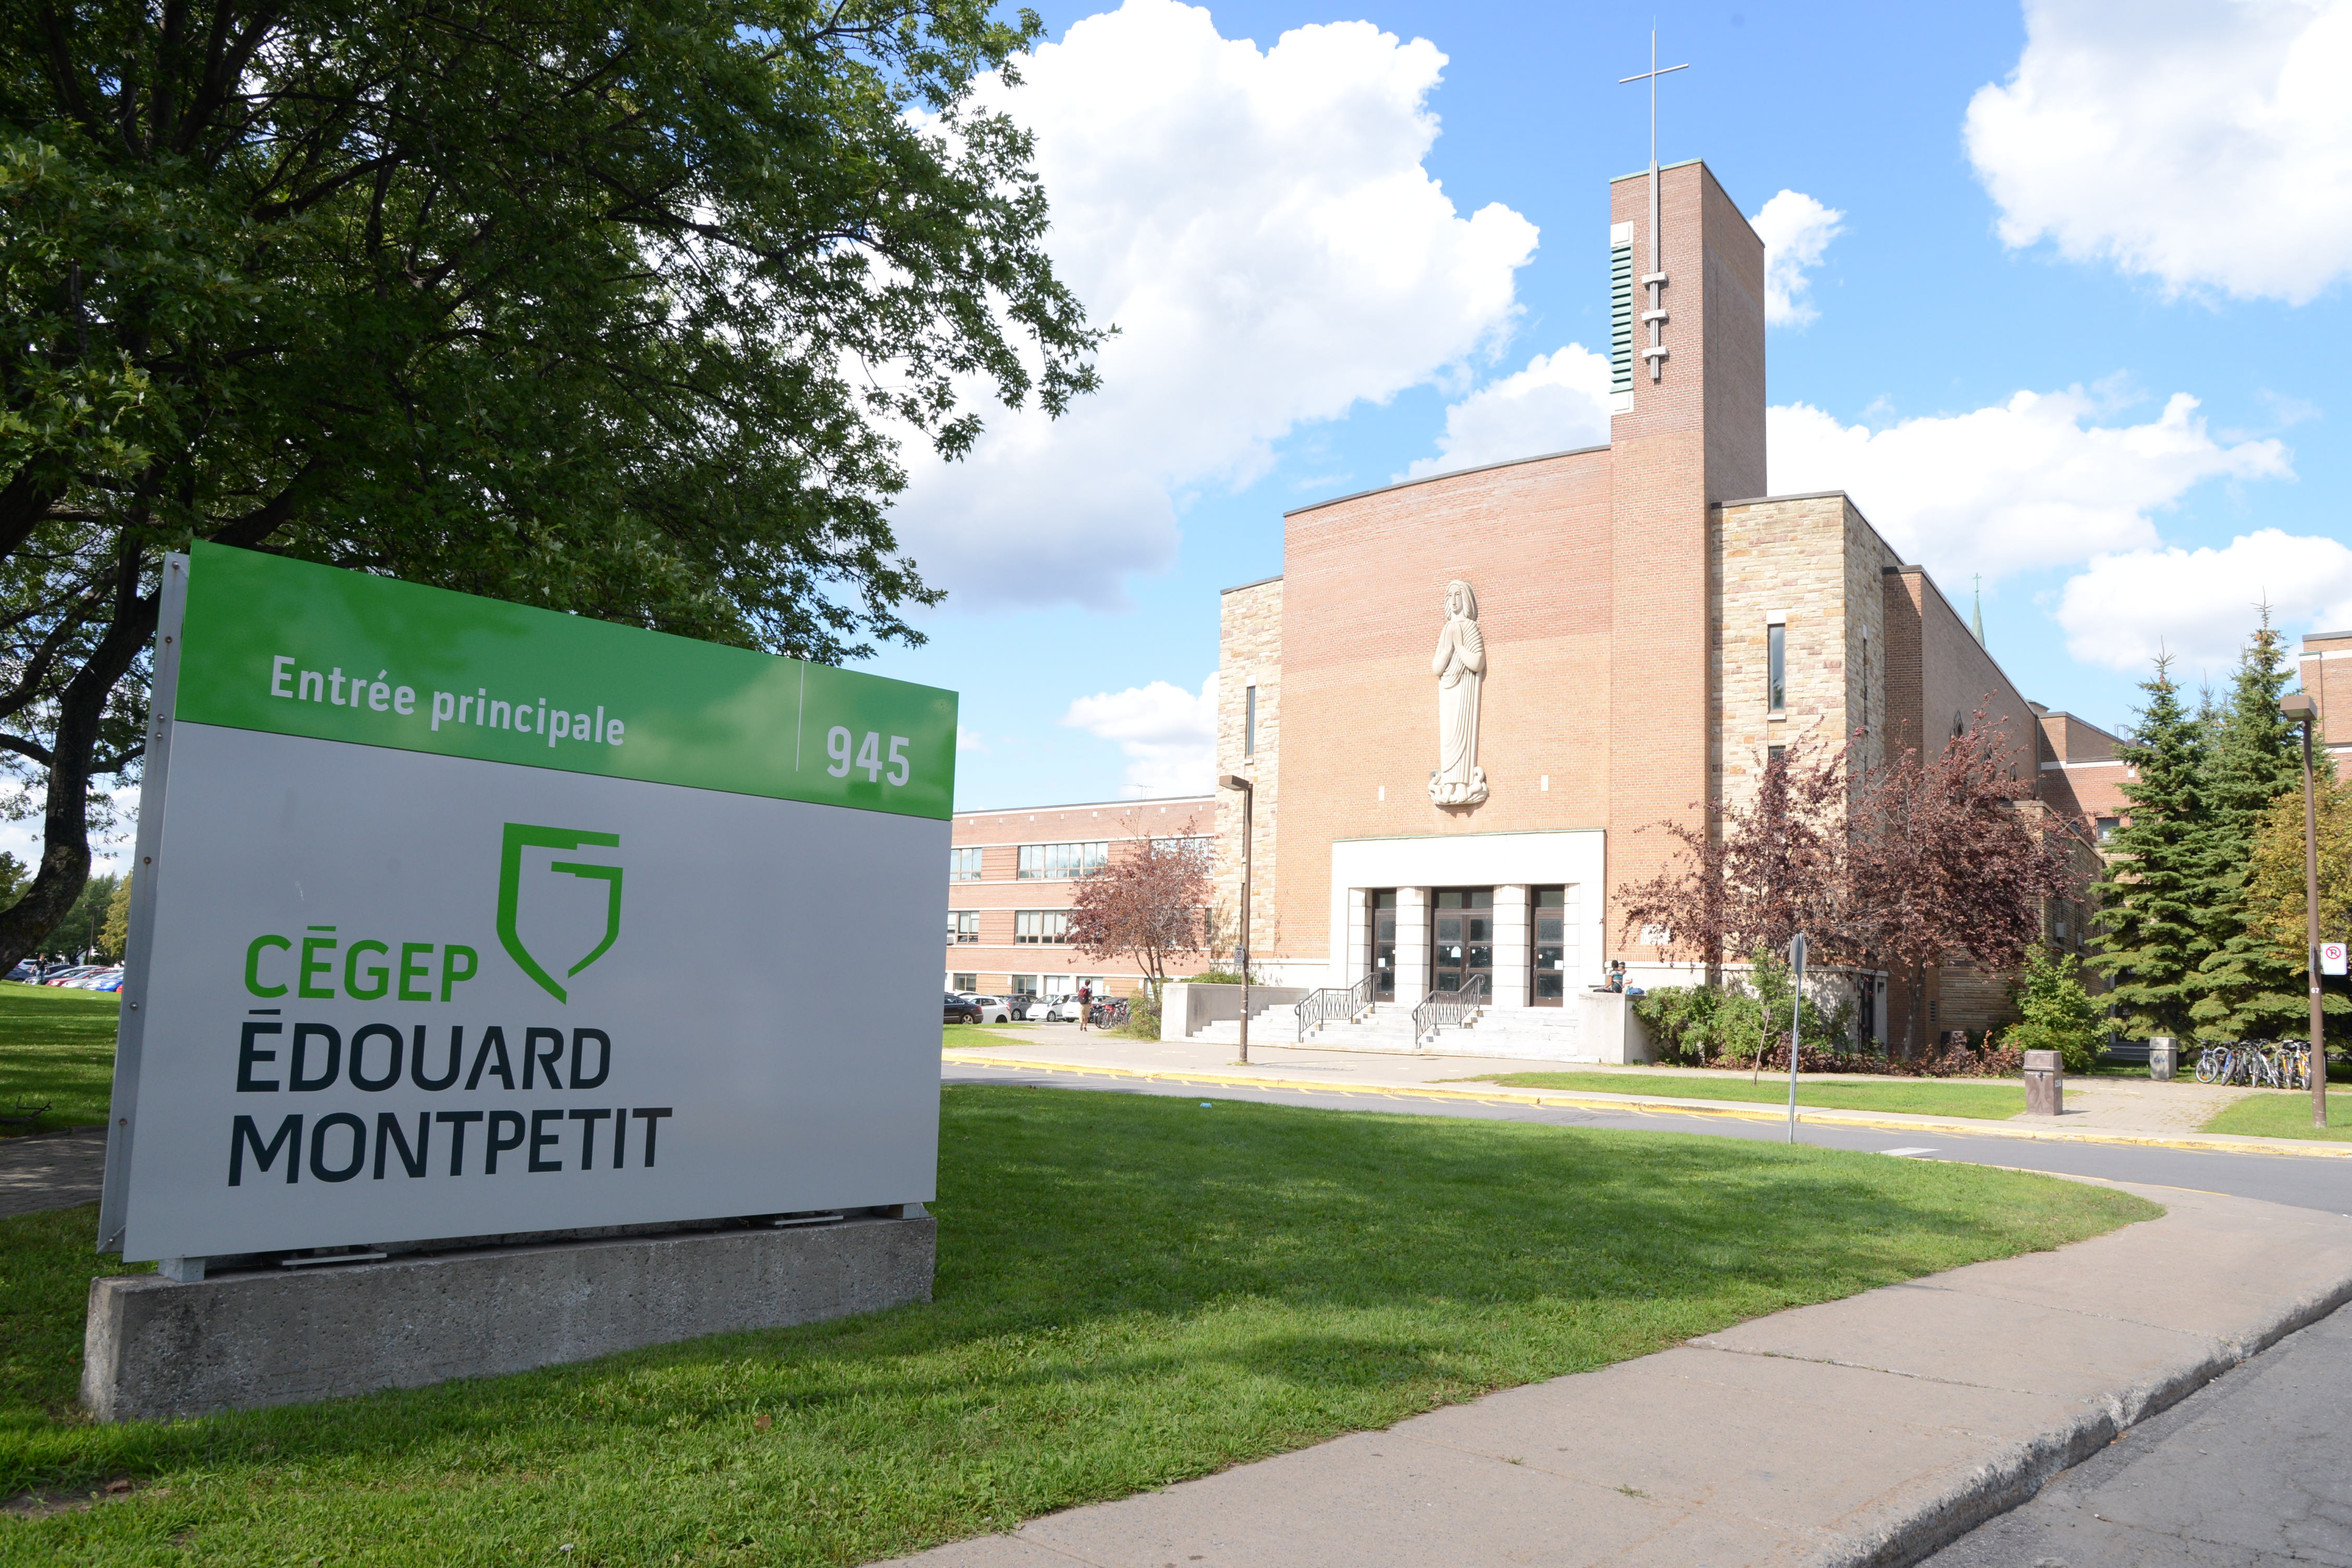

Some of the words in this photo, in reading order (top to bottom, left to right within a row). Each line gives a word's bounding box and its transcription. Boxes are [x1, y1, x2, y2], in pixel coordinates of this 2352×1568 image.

[271, 655, 416, 716] Entrée
[431, 687, 625, 748] principale
[826, 725, 910, 787] 945
[227, 1107, 673, 1187] MONTPETIT
